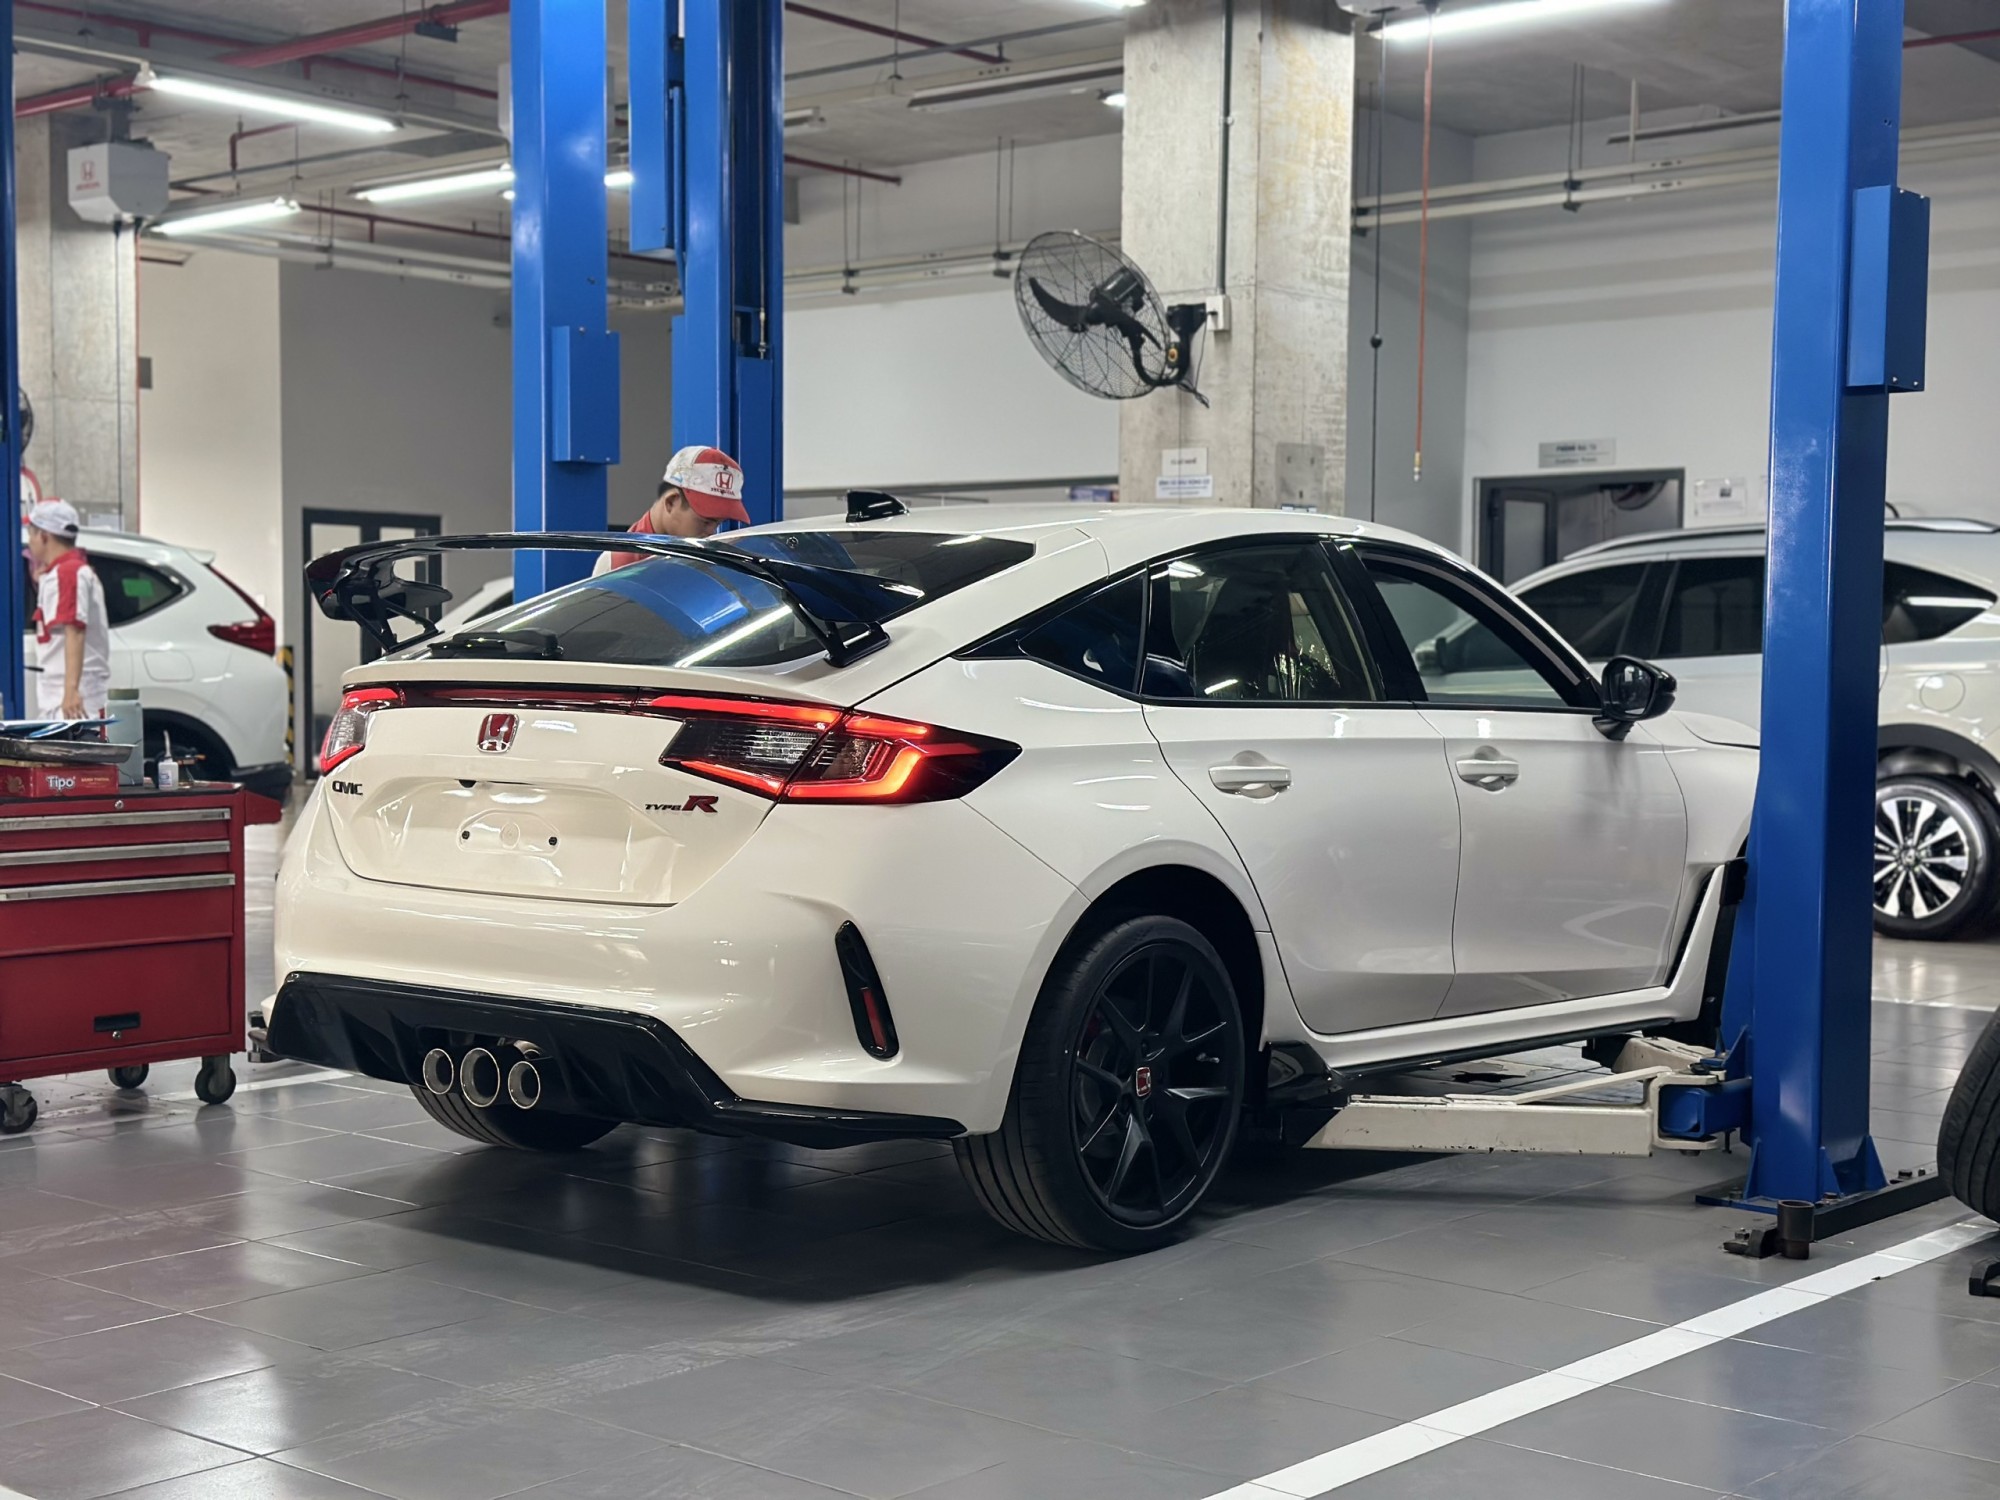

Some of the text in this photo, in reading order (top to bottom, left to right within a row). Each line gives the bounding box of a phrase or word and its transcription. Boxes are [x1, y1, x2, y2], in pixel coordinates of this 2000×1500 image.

[47, 775, 74, 791] Tipo
[644, 795, 719, 813] TYPE R
